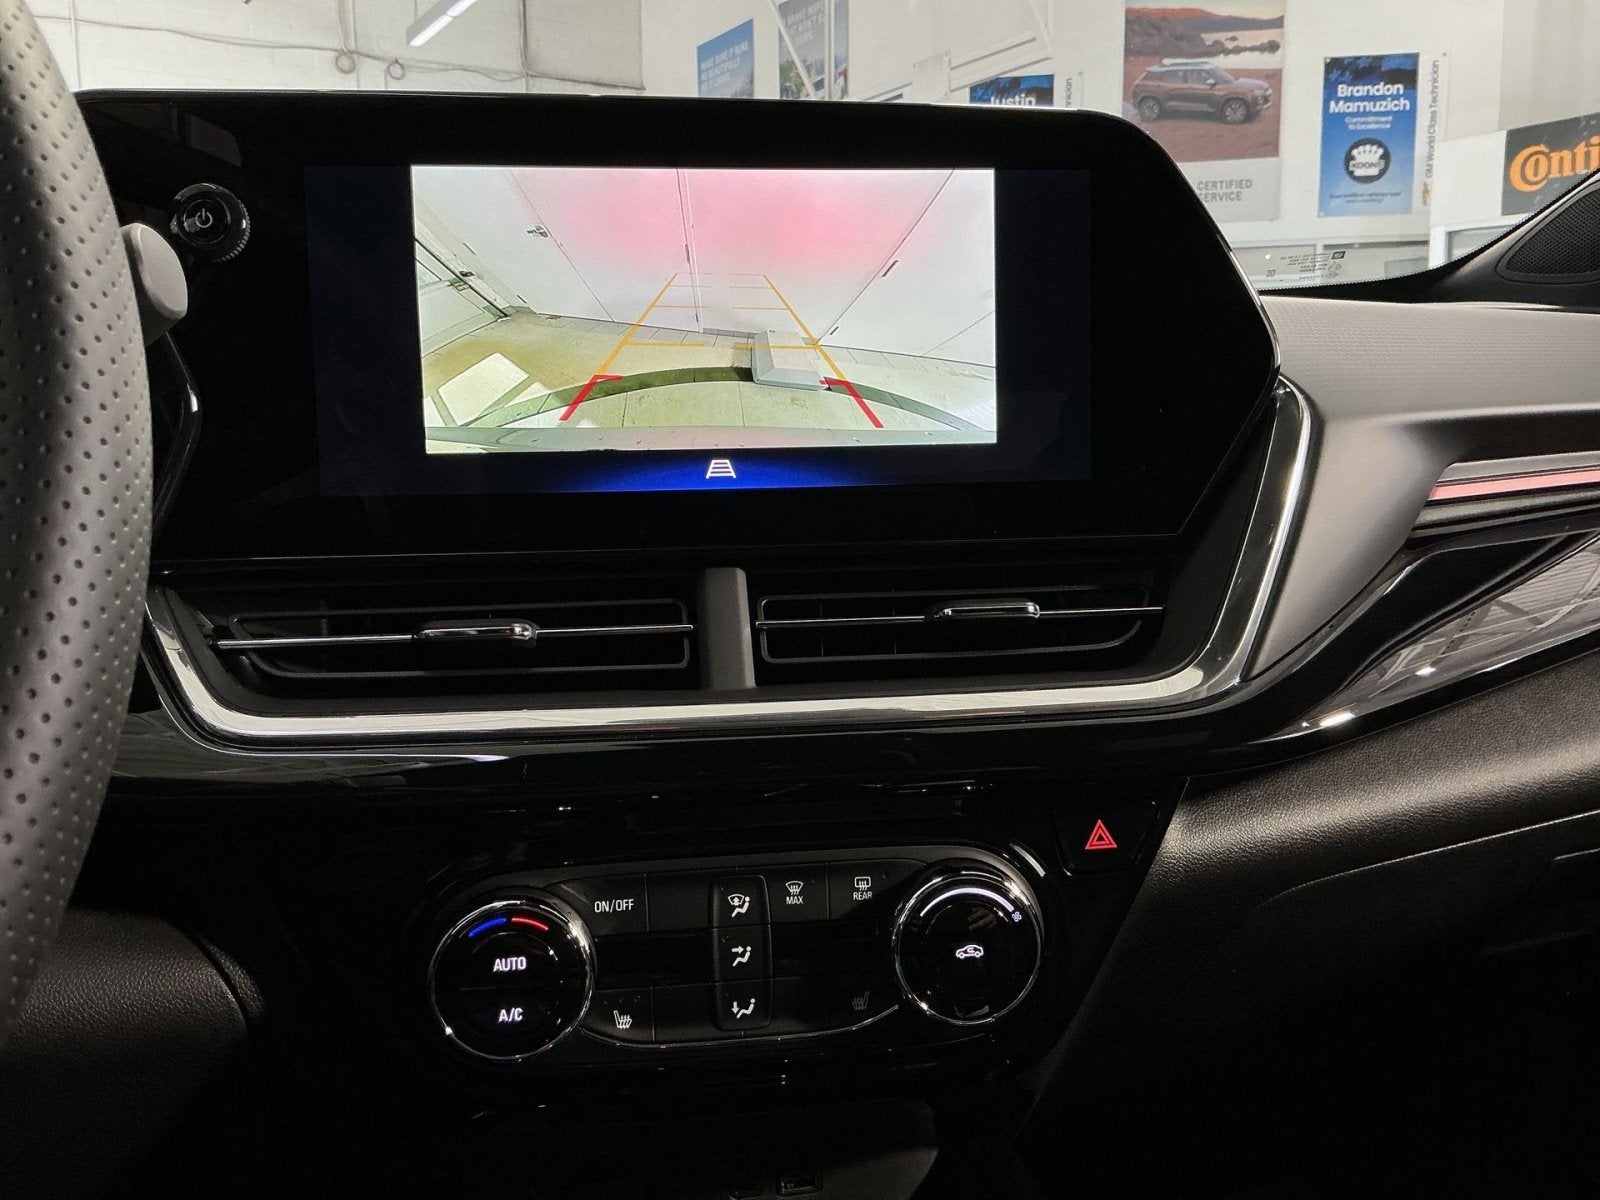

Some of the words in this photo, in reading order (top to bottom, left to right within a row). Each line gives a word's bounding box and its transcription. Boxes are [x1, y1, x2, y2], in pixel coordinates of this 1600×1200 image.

[1337, 82, 1404, 97] Brandon
[1429, 59, 1440, 108] Technician
[1329, 98, 1411, 113] Mamuzich
[1428, 110, 1437, 134] Class
[1427, 136, 1436, 161] World
[1197, 179, 1253, 191] CERTIFIED
[786, 895, 804, 905] MAX
[852, 890, 873, 900] REAR
[594, 899, 635, 913] ON/OFF
[493, 956, 527, 972] AUTO
[498, 1007, 523, 1023] A/C
